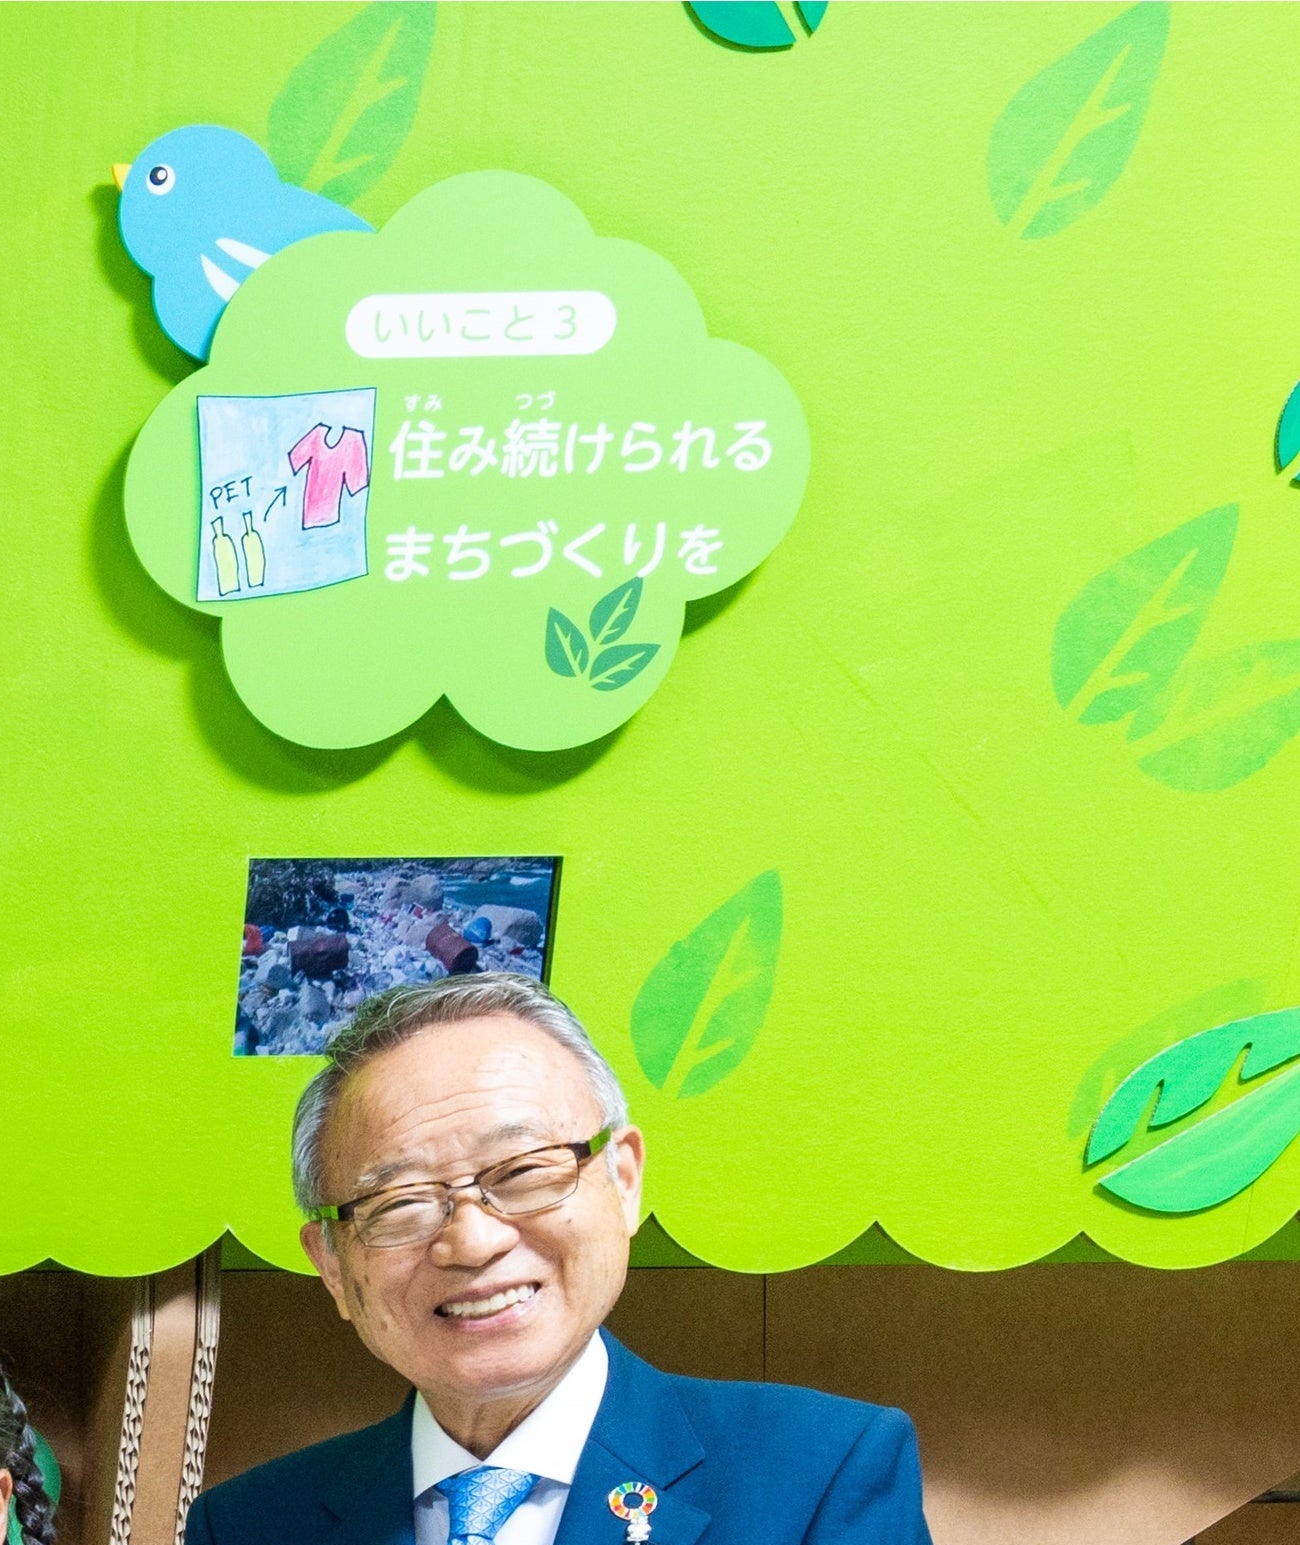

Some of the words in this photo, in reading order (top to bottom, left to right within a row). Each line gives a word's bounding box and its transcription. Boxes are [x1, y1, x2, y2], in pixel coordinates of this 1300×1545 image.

[404, 393, 442, 412] すみ
[515, 390, 556, 411] つづ
[388, 417, 773, 481] 住み続けられる
[209, 477, 254, 510] PET
[384, 519, 724, 582] まちづくりを
